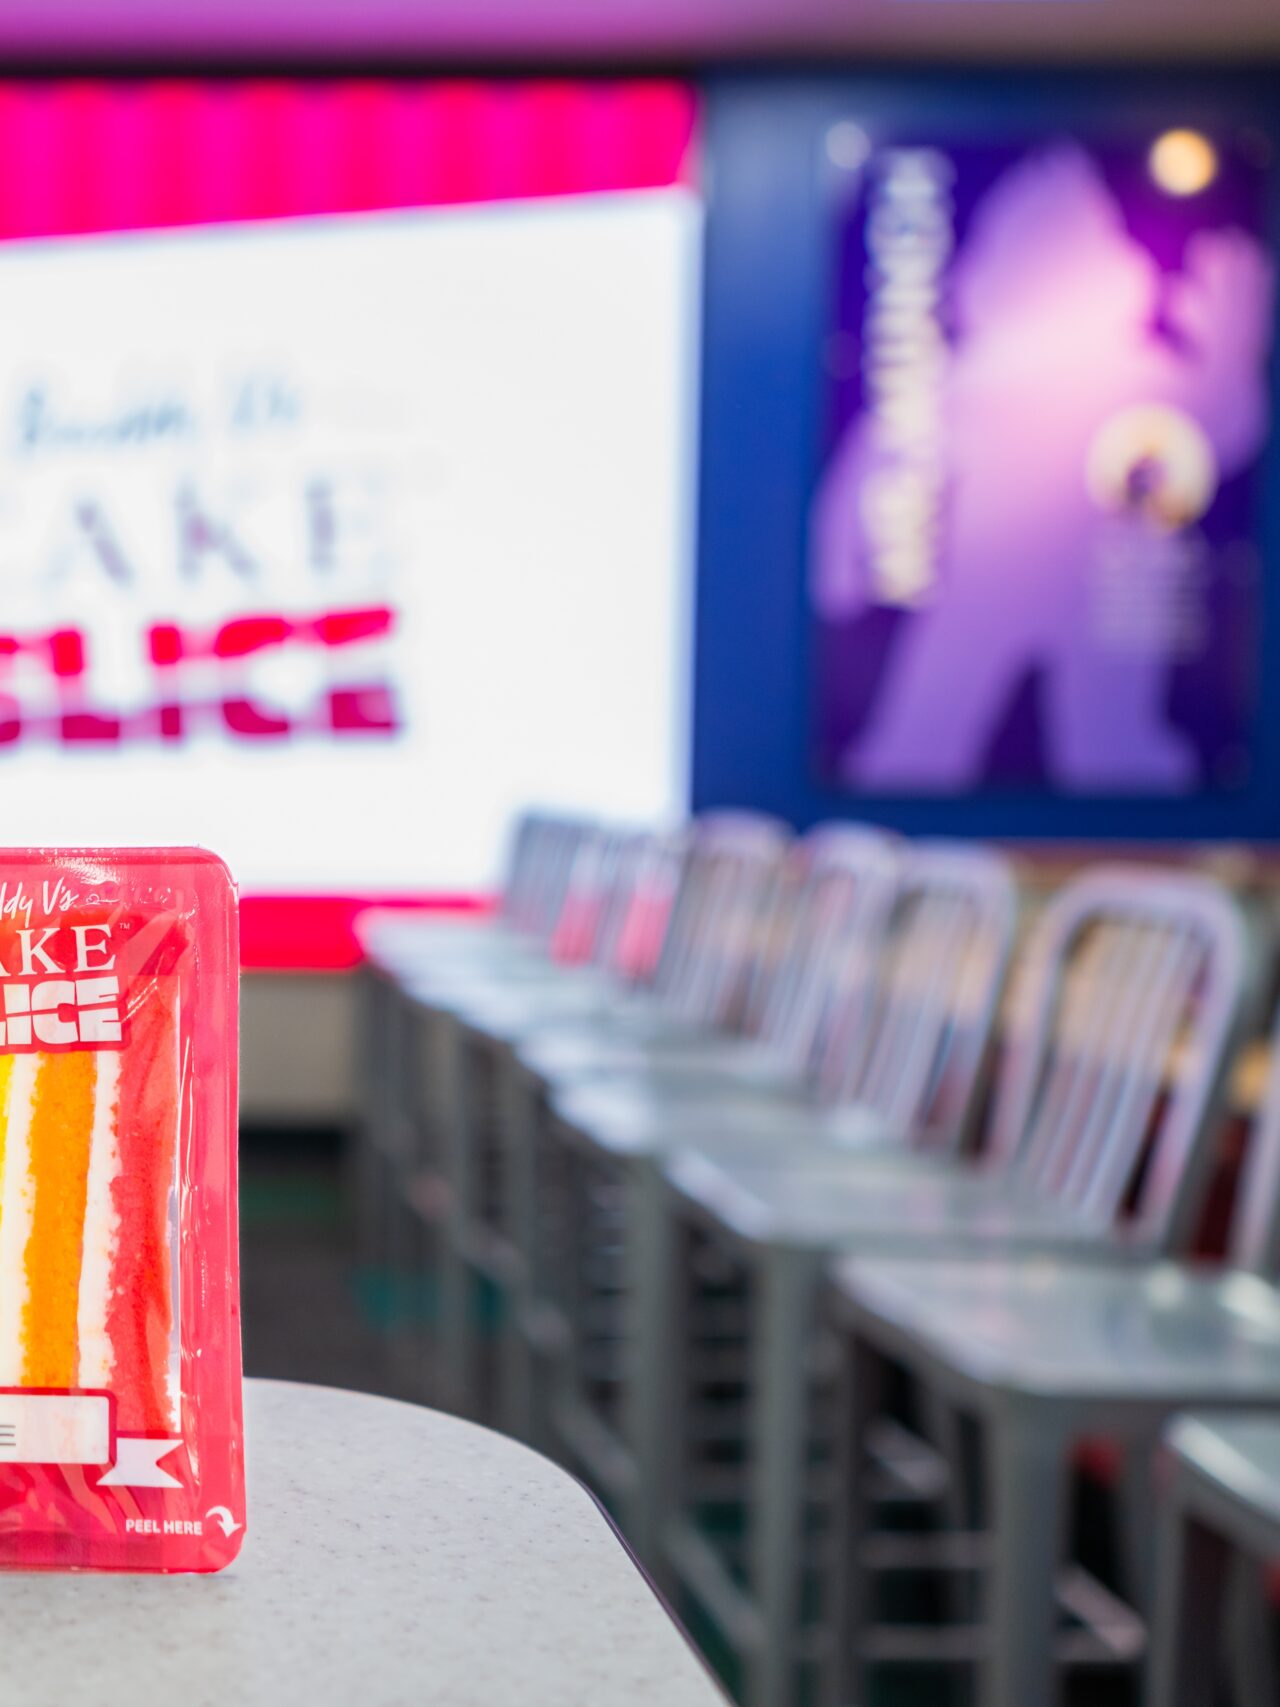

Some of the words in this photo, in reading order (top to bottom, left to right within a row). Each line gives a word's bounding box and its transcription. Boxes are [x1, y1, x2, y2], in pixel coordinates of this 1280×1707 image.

[42, 876, 79, 916] V's
[125, 1519, 161, 1534] PEEL
[163, 1520, 203, 1536] HERE
